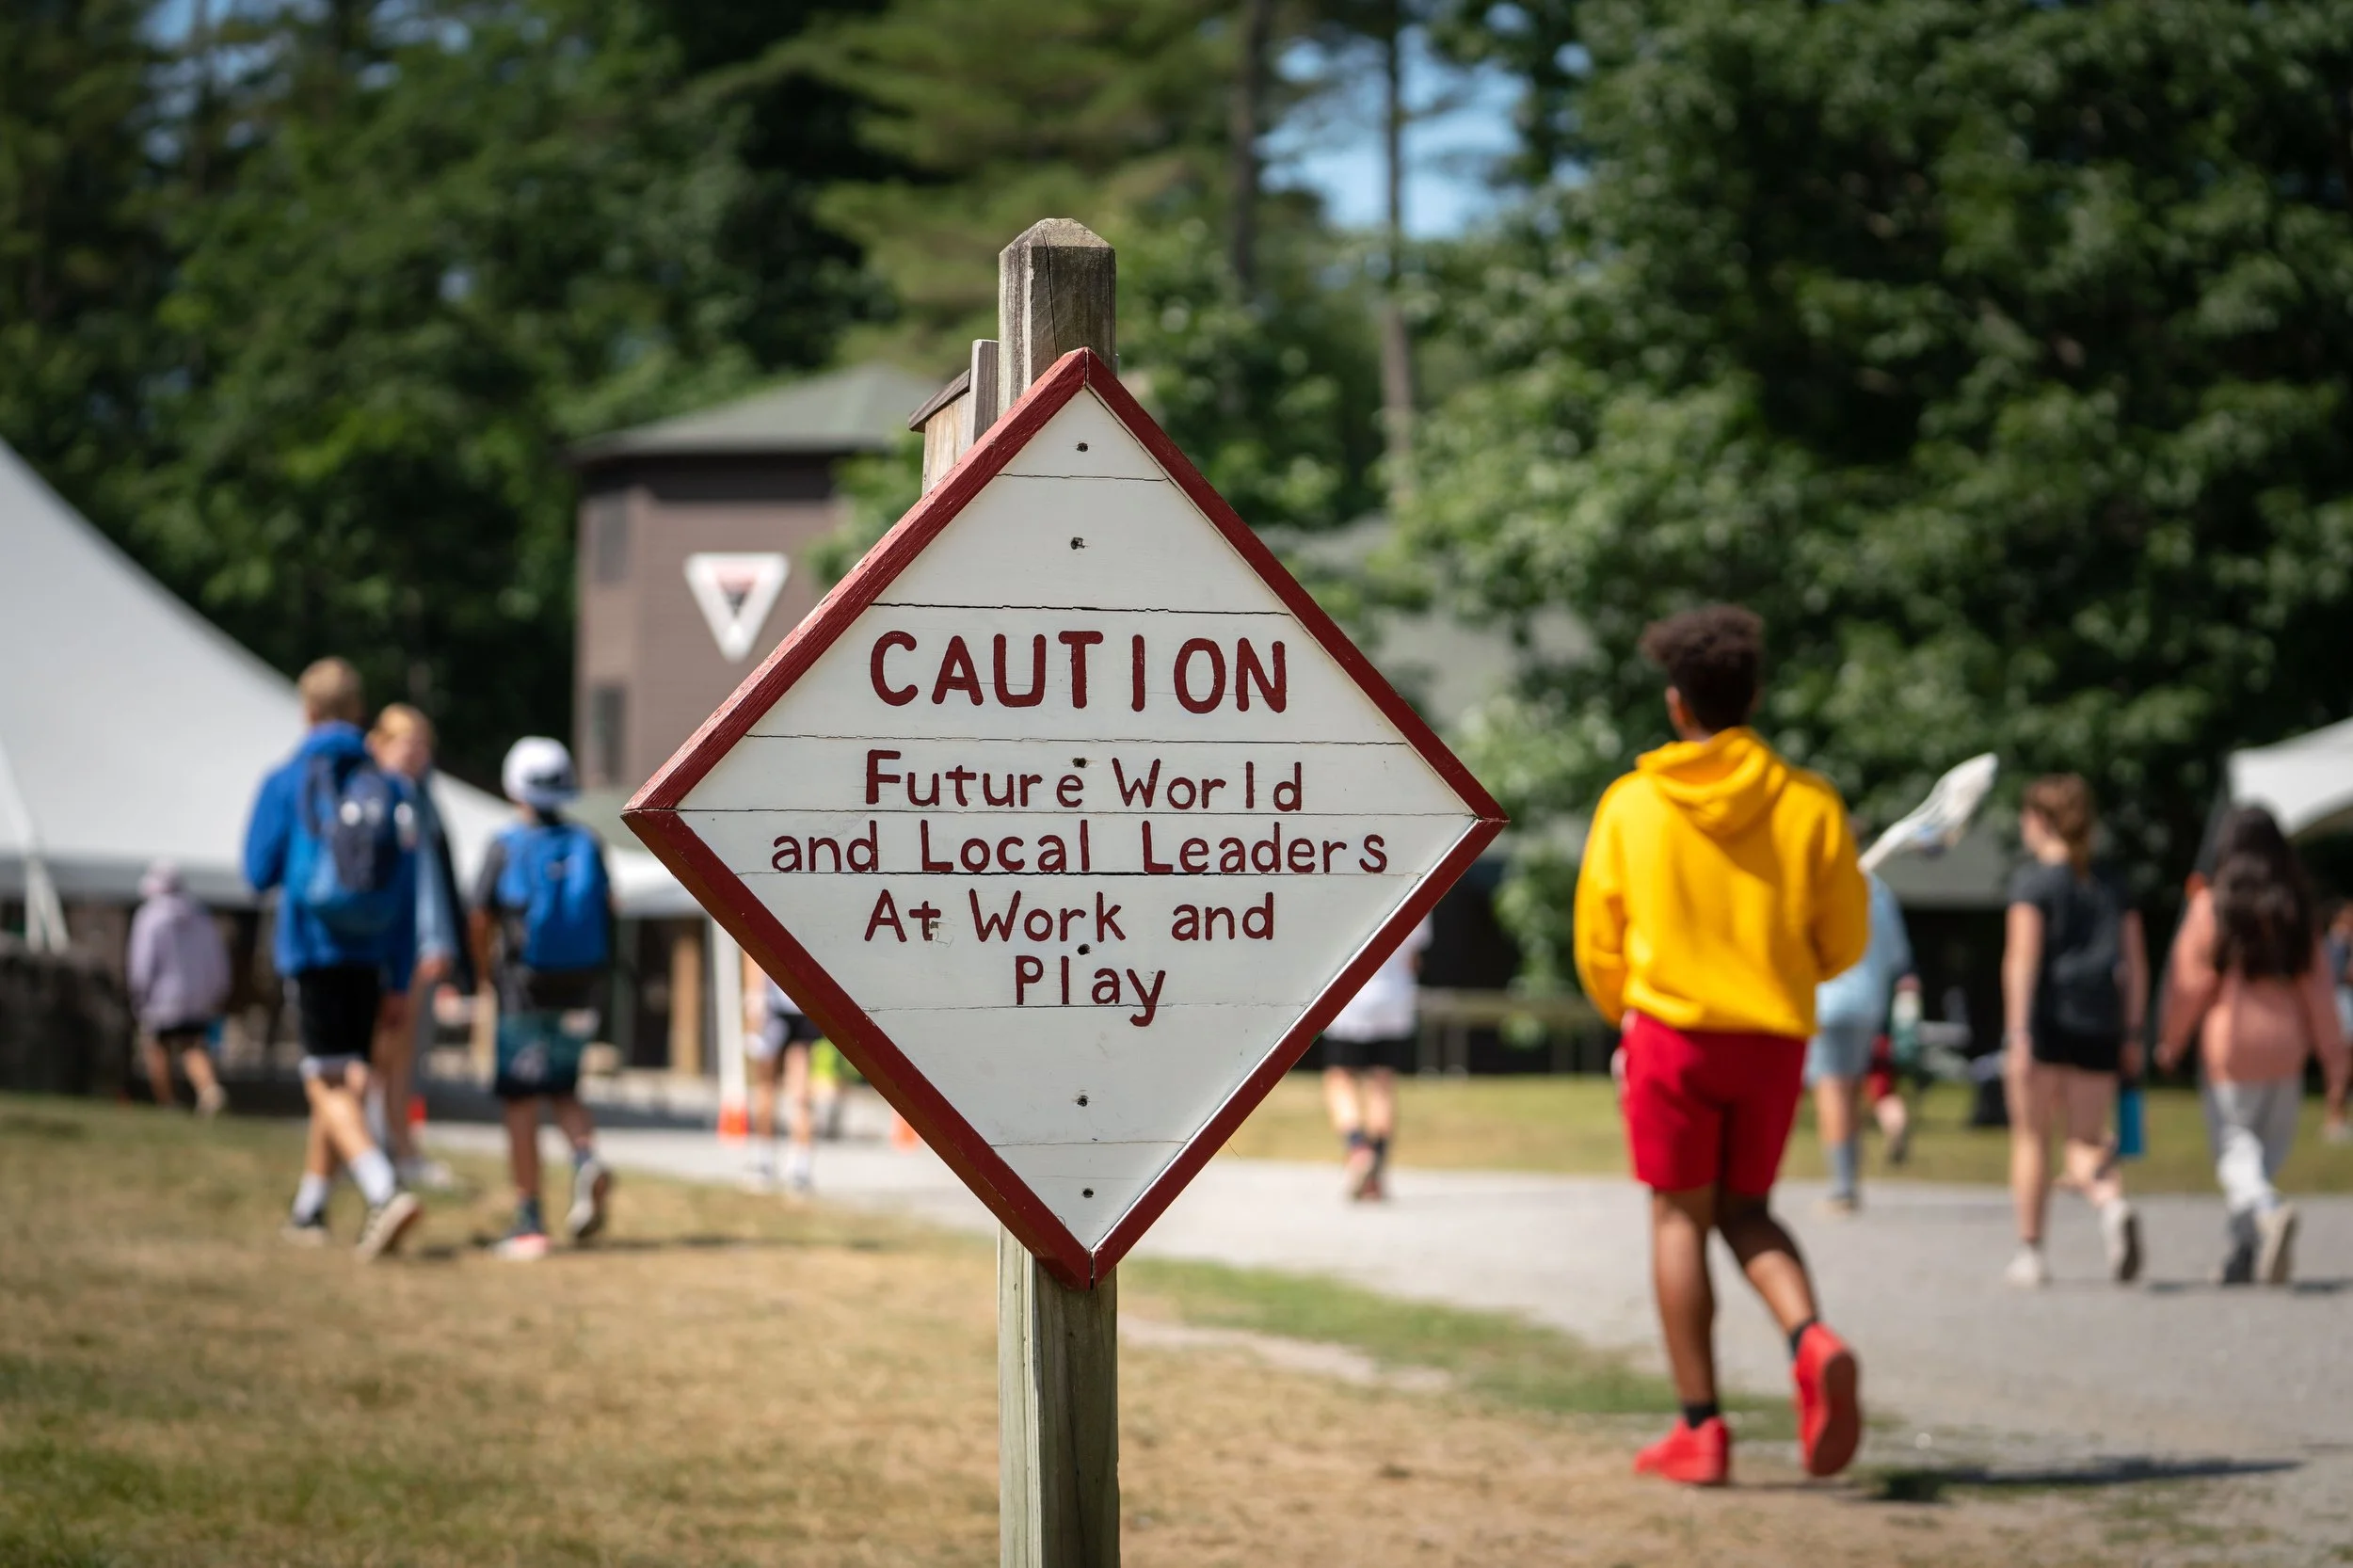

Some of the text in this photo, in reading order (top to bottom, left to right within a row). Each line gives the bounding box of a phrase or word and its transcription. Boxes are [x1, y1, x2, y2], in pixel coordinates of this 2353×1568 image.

[870, 631, 1287, 713] CAUTION
[866, 749, 1303, 811] Future World
[772, 820, 1388, 873] and Local Leaders
[865, 888, 1273, 942] At Work and
[1016, 955, 1165, 1027] Play
